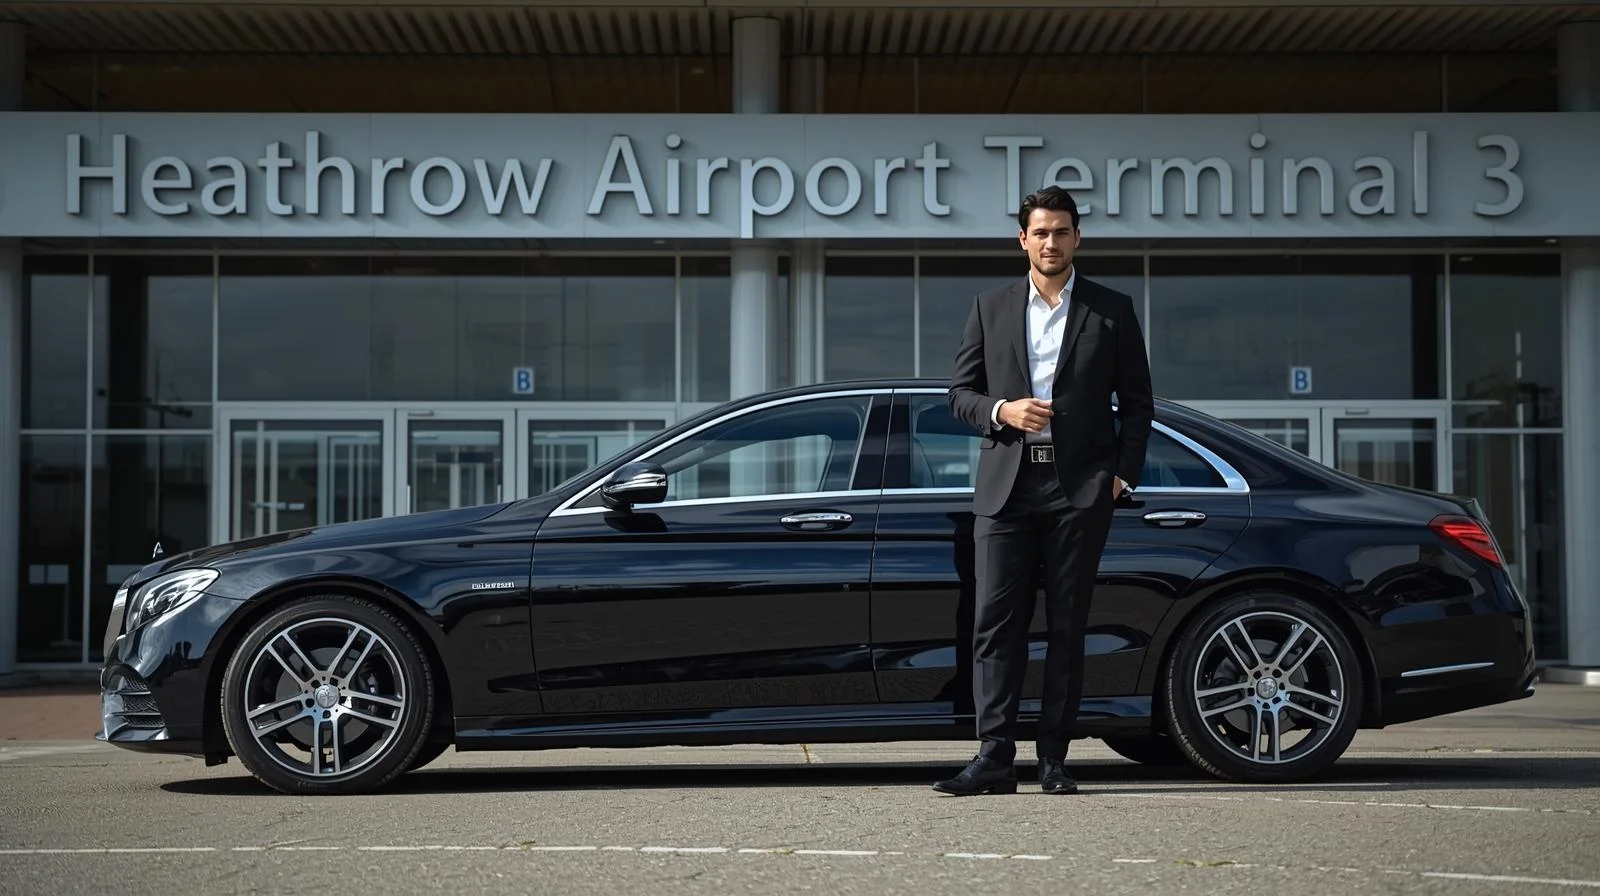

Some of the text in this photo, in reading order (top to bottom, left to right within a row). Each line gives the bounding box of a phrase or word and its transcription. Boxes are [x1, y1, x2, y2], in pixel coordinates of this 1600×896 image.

[66, 131, 1524, 238] Heathrow Airport Terminal 3
[517, 370, 530, 391] B
[1295, 370, 1308, 390] B
